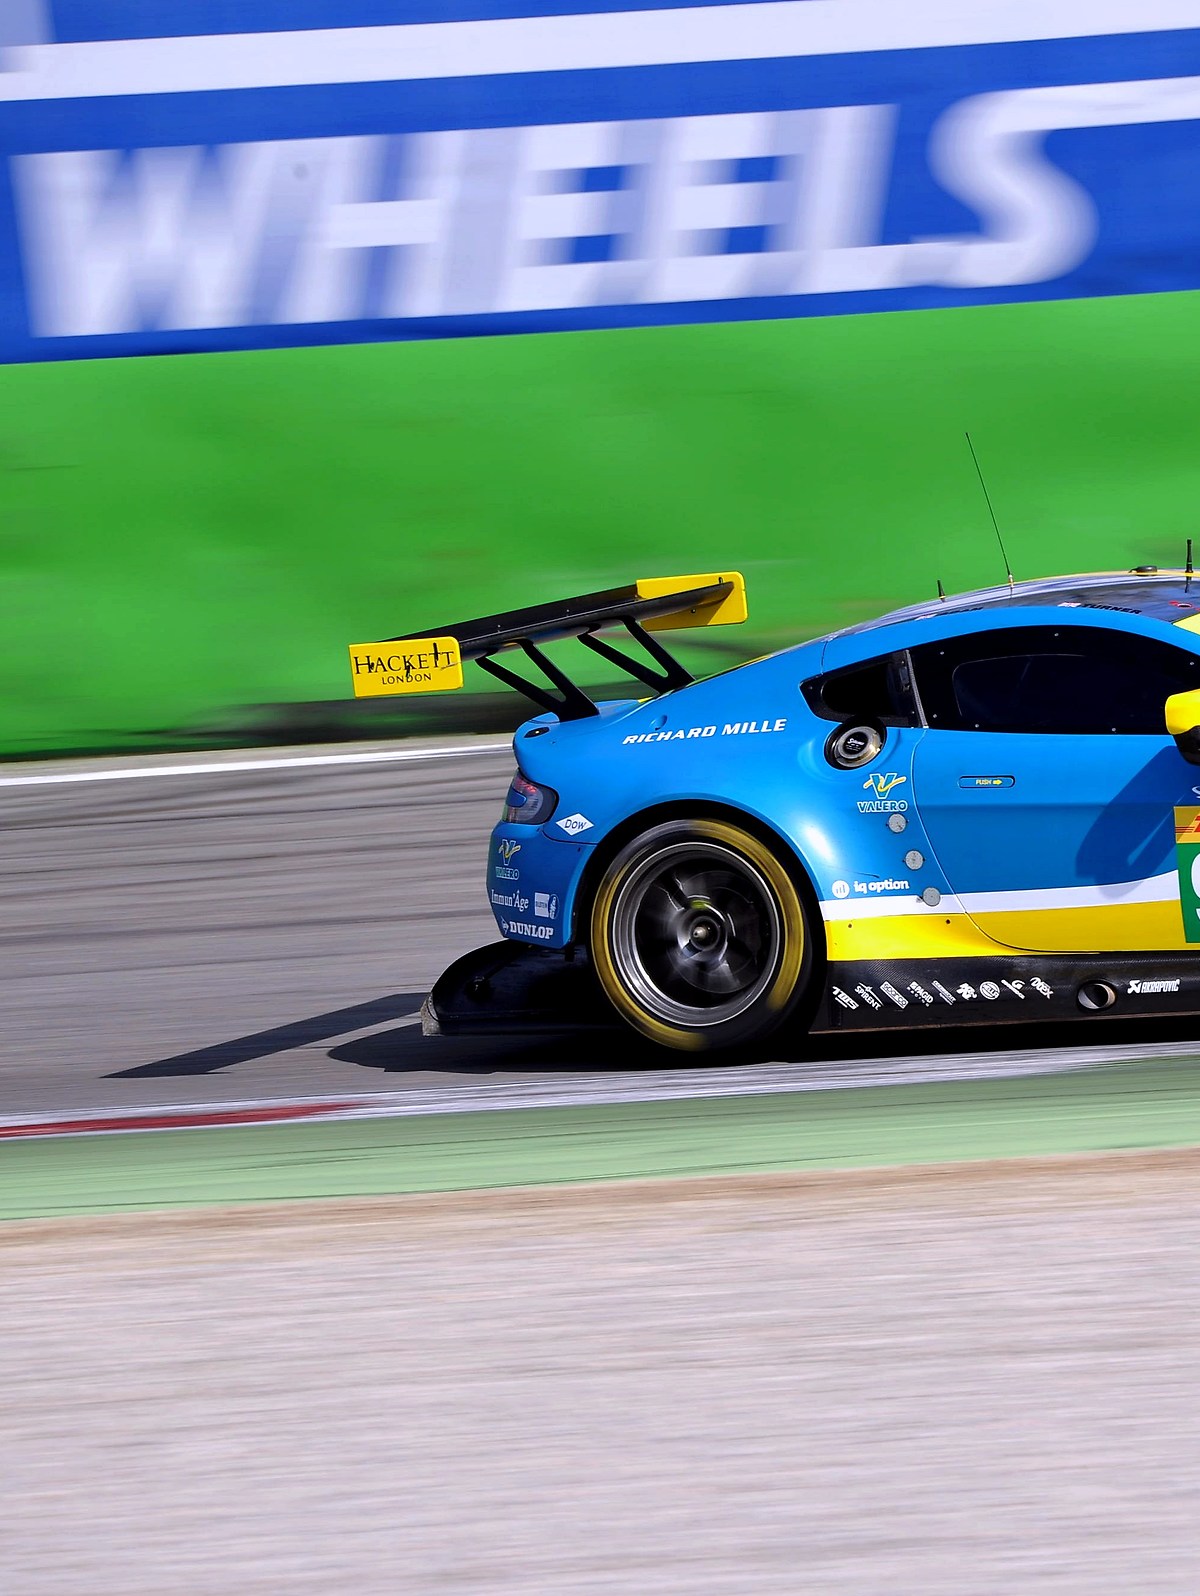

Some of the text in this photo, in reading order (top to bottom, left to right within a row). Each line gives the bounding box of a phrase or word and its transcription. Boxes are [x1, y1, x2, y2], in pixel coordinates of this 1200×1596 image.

[9, 88, 1100, 340] WHEELS
[1081, 602, 1143, 616] TURNER
[353, 651, 455, 675] HACKETT
[381, 673, 432, 685] LONDON
[622, 718, 788, 745] RICHARD MILLE
[857, 800, 909, 812] VALERO
[868, 878, 910, 893] option
[509, 921, 554, 939] DUNLOP
[854, 985, 881, 1010] SPIRENT
[913, 985, 934, 1003] PAGID
